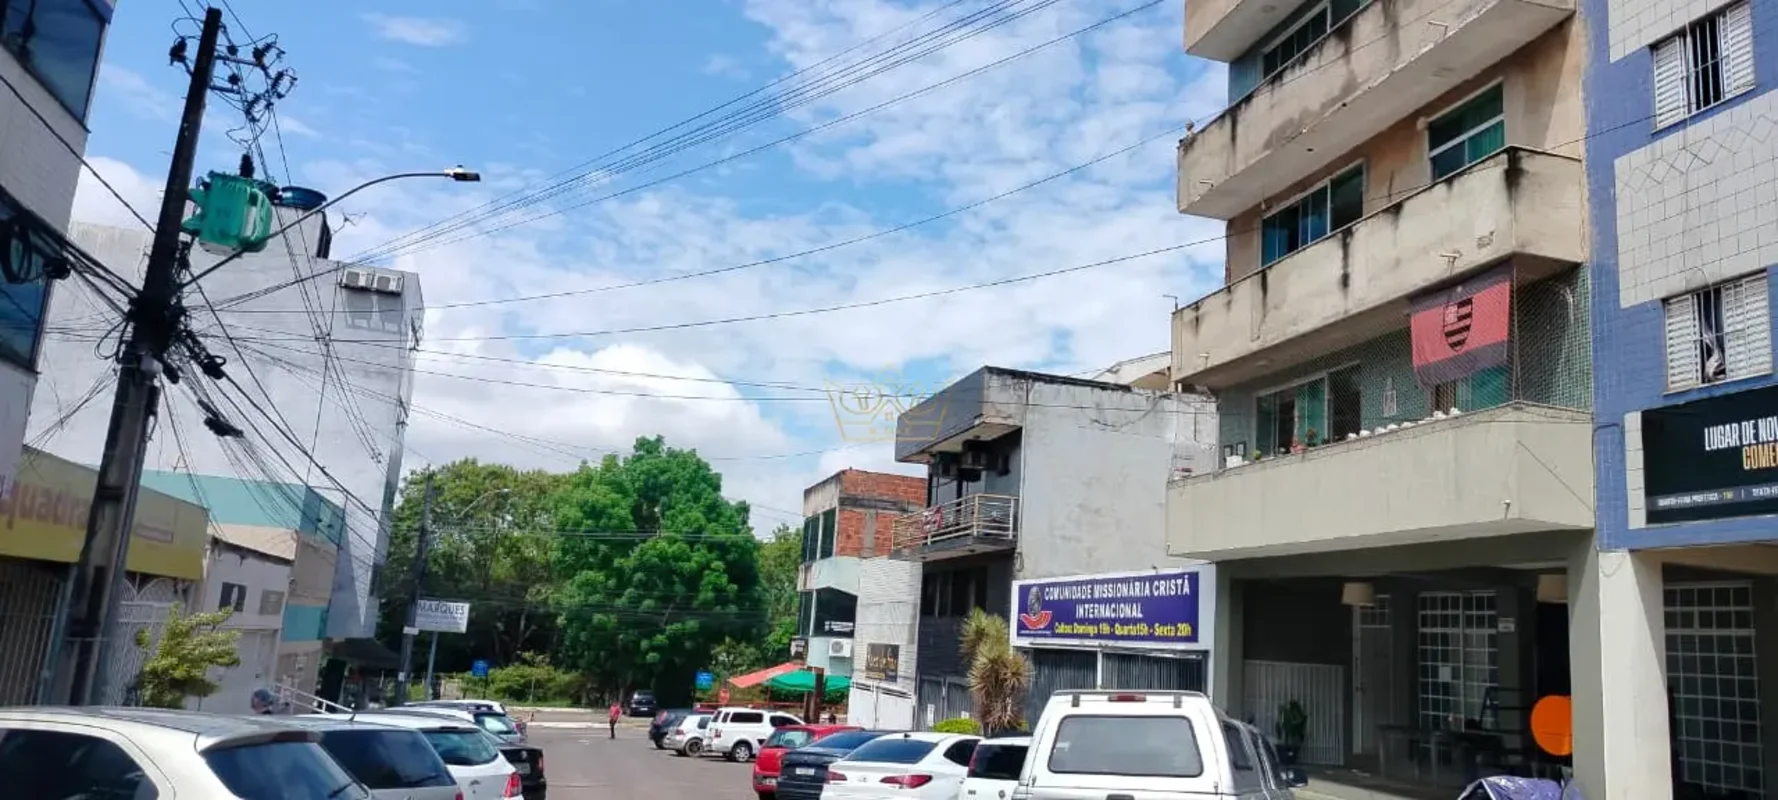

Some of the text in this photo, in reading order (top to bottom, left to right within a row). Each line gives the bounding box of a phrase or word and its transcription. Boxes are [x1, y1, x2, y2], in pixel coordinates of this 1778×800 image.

[1704, 423, 1740, 451] LUGAR
[1741, 420, 1757, 446] DE
[1044, 584, 1092, 601] COMUNIDADE
[1152, 575, 1190, 597] CRISTÃ
[418, 602, 465, 615] MARQUES
[1075, 602, 1143, 619] INTERNACIONAL
[1154, 622, 1176, 636] Sexta
